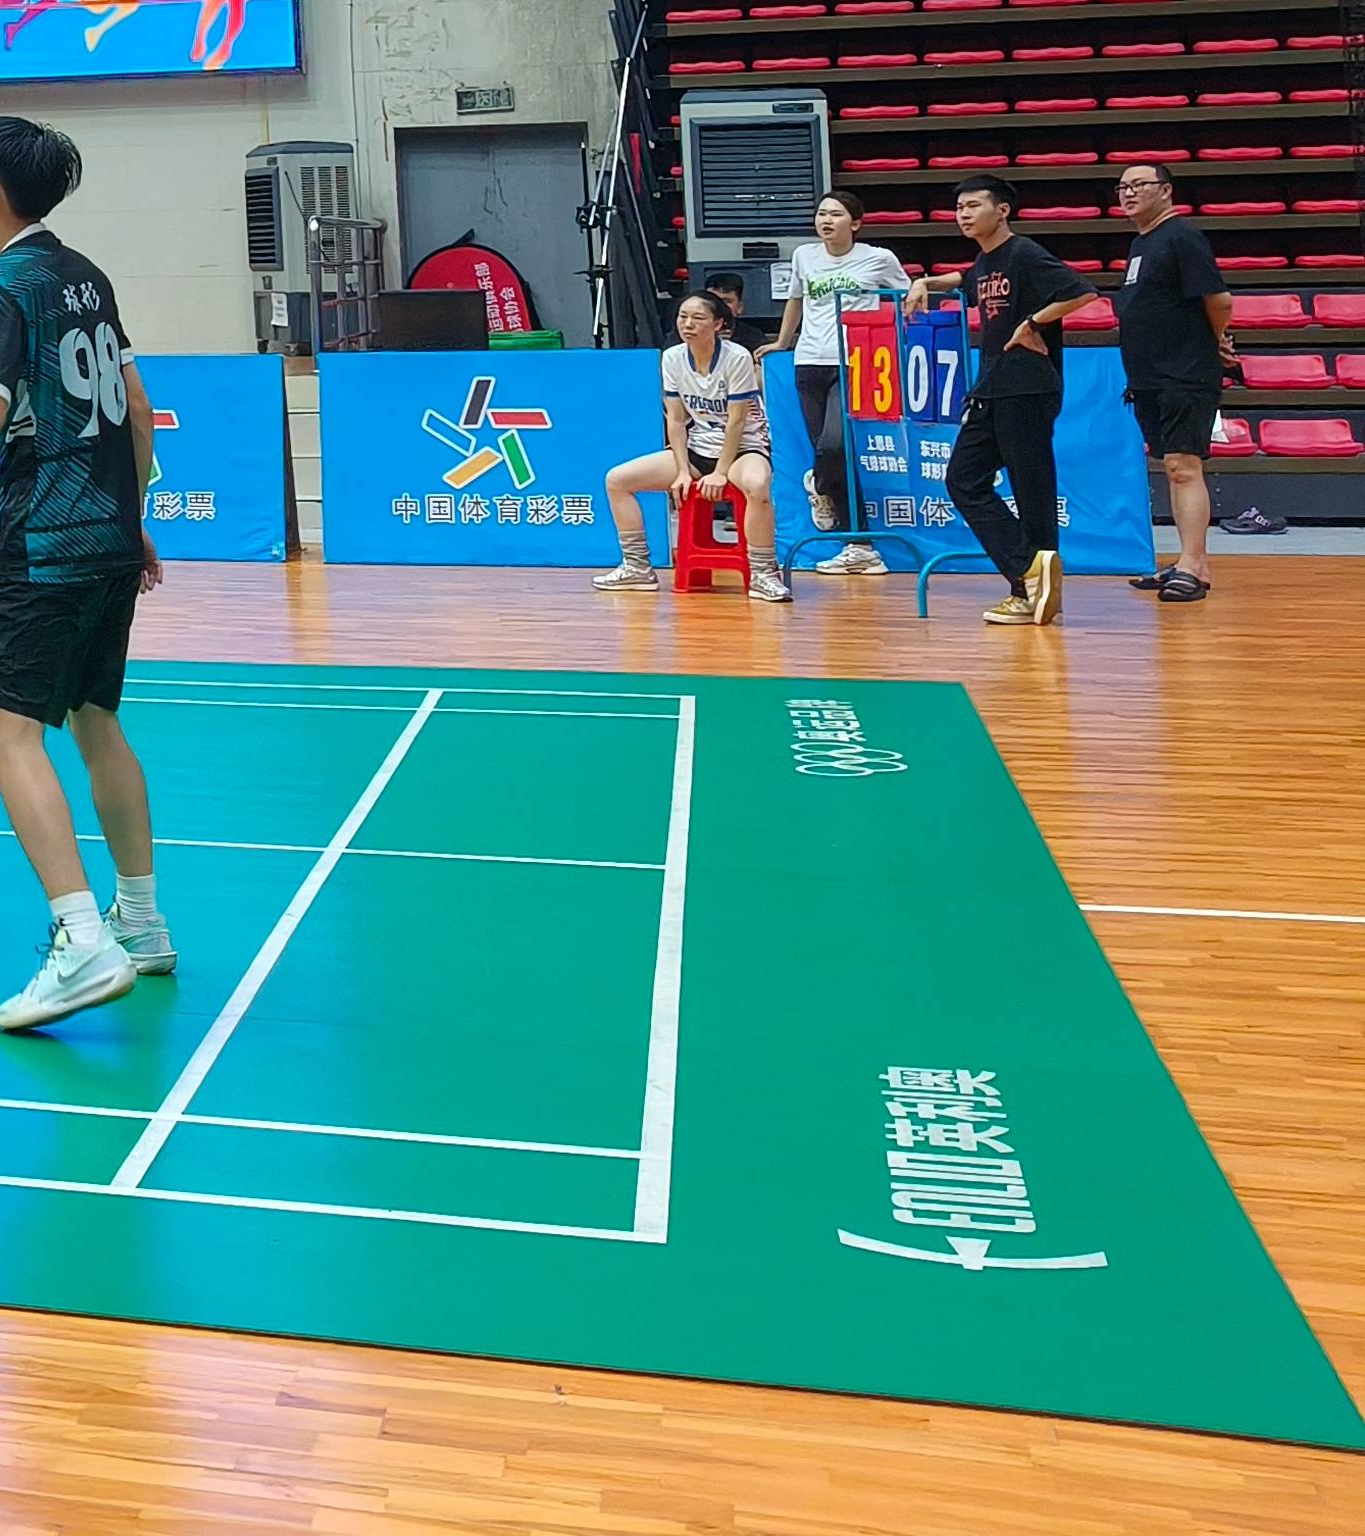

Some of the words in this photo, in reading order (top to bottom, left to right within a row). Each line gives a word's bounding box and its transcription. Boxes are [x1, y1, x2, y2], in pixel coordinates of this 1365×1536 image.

[58, 322, 128, 439] 98
[848, 346, 893, 413] 13
[907, 345, 959, 417] 07
[143, 491, 216, 521] 彩票
[392, 492, 596, 526] 中国体育彩票
[879, 1065, 1015, 1154] 英利奥
